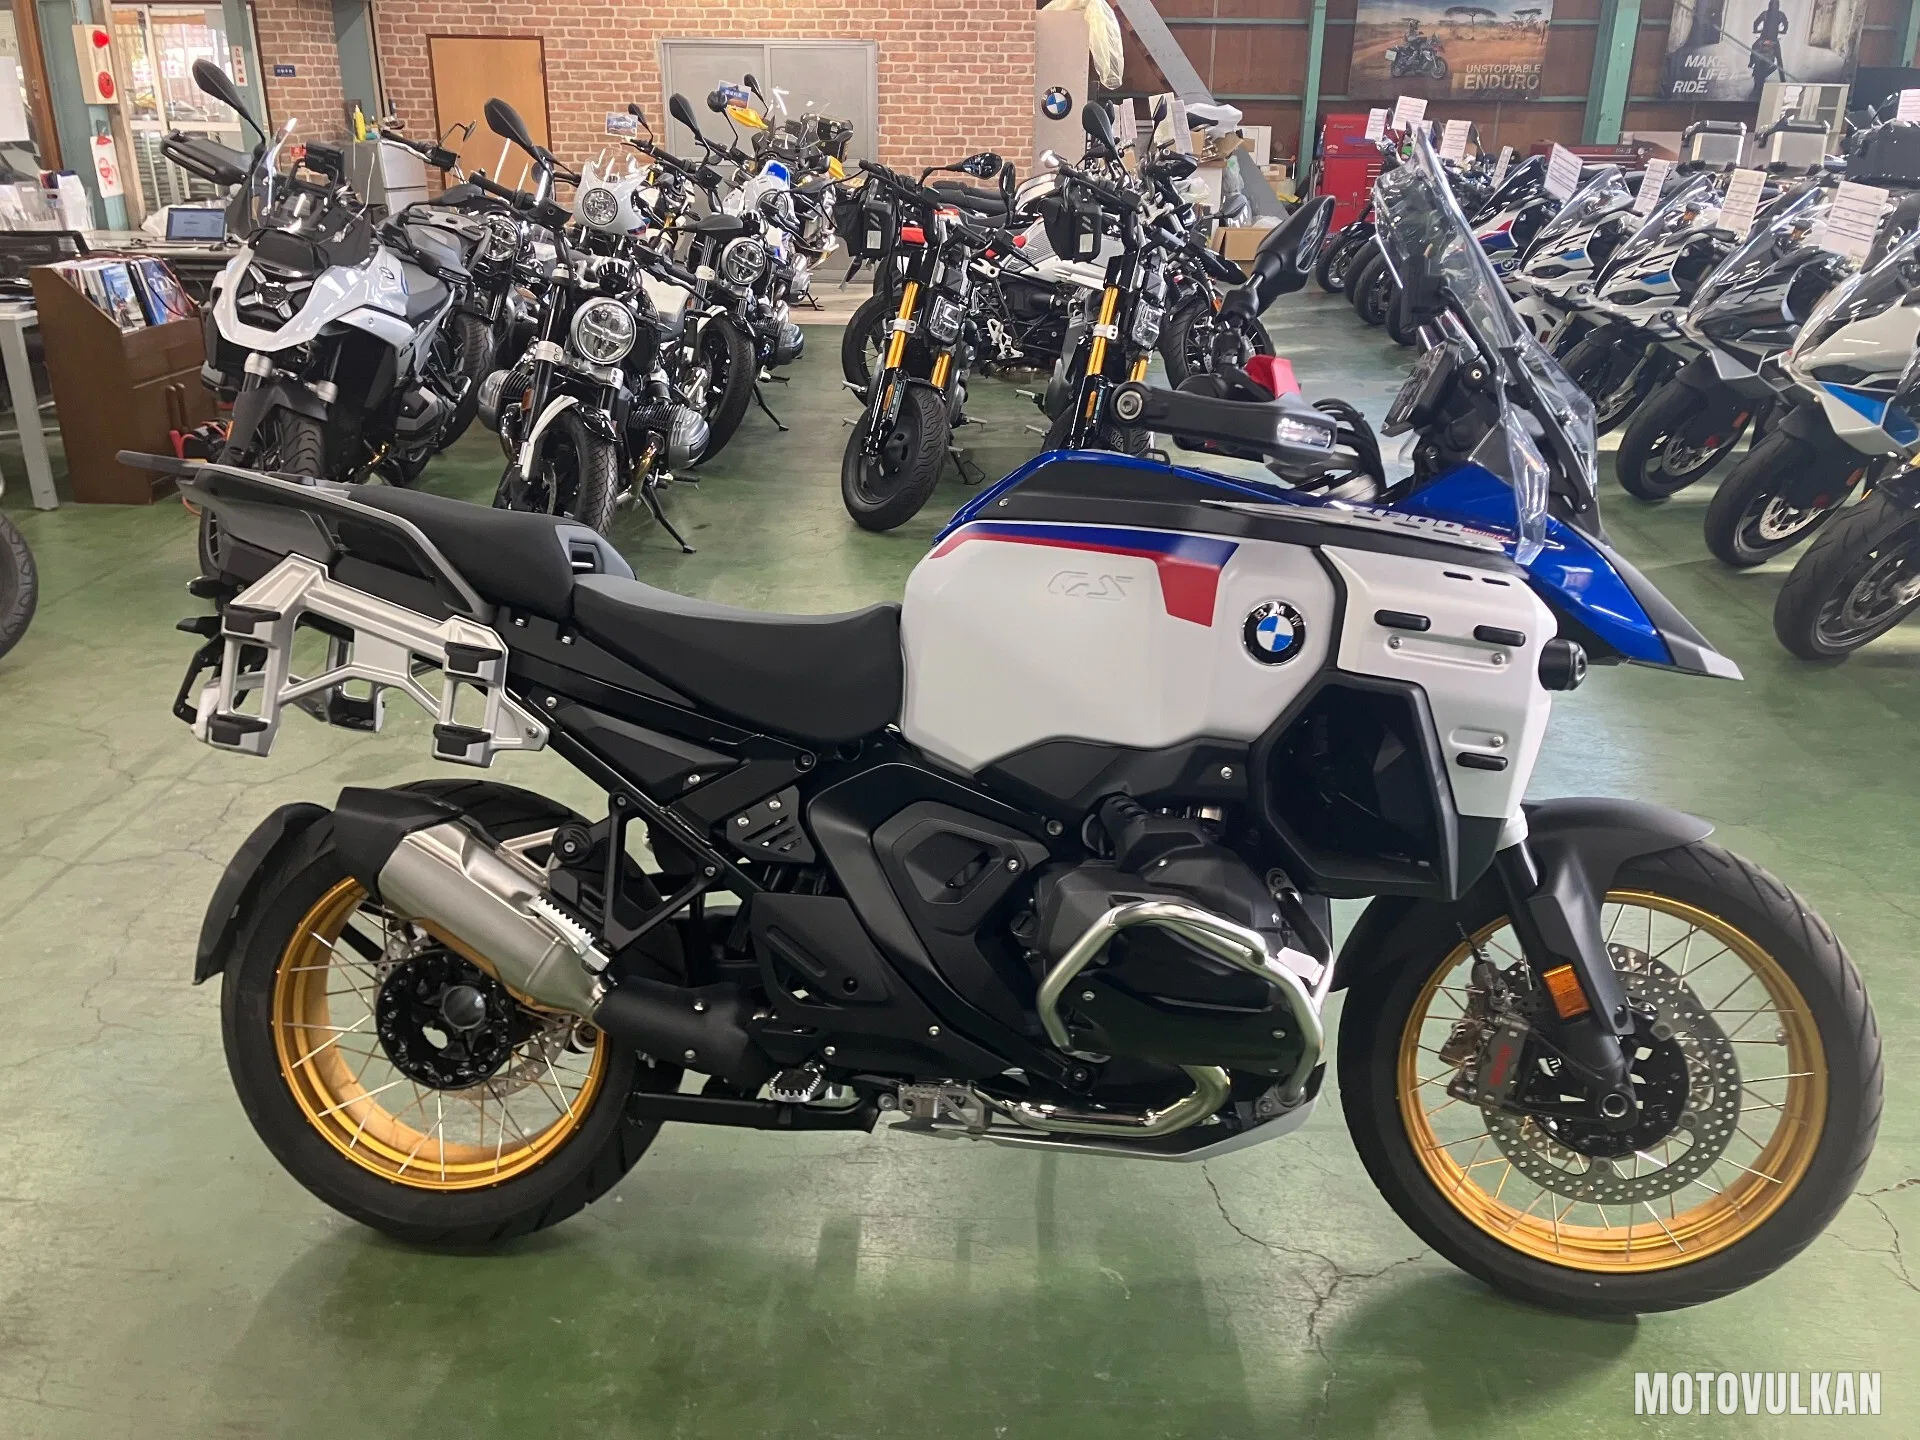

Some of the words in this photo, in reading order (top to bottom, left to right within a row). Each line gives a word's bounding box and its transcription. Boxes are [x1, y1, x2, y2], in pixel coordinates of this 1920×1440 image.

[1684, 54, 1726, 68] MAKE
[1466, 64, 1542, 74] UNSTOPPABLE
[1697, 68, 1728, 80] LIFE
[1464, 74, 1540, 90] ENDURO
[1672, 80, 1708, 93] RIDE.
[1047, 570, 1134, 601] GS
